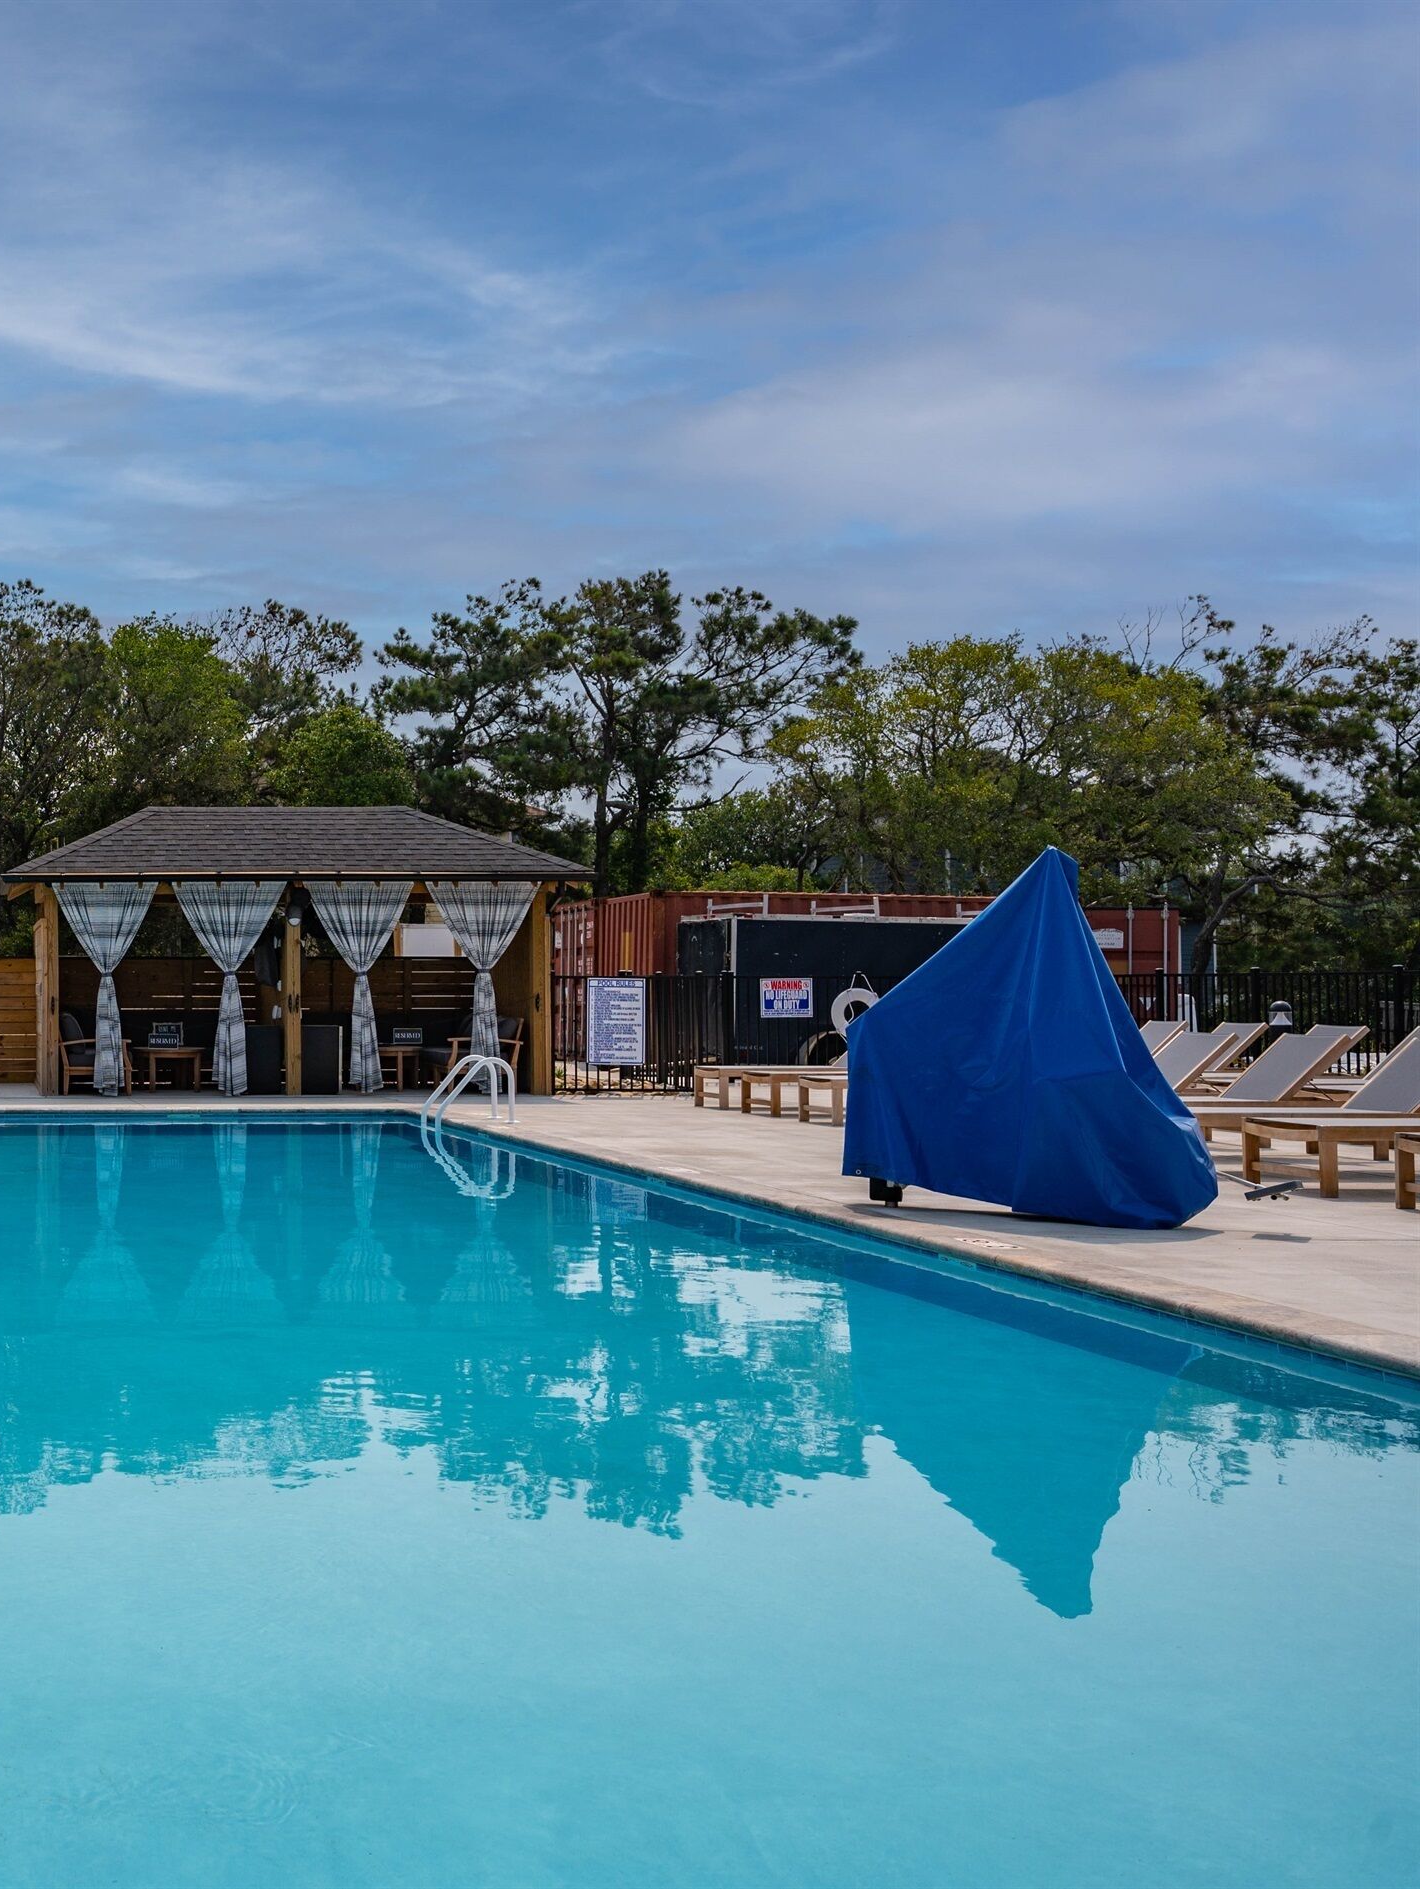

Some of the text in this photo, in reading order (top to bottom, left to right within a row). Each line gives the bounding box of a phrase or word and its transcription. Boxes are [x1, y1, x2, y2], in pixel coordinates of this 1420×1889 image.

[770, 980, 803, 990] WARNING
[765, 990, 808, 1000] NO LIFEGUARD
[773, 1000, 800, 1009] ON DUTY
